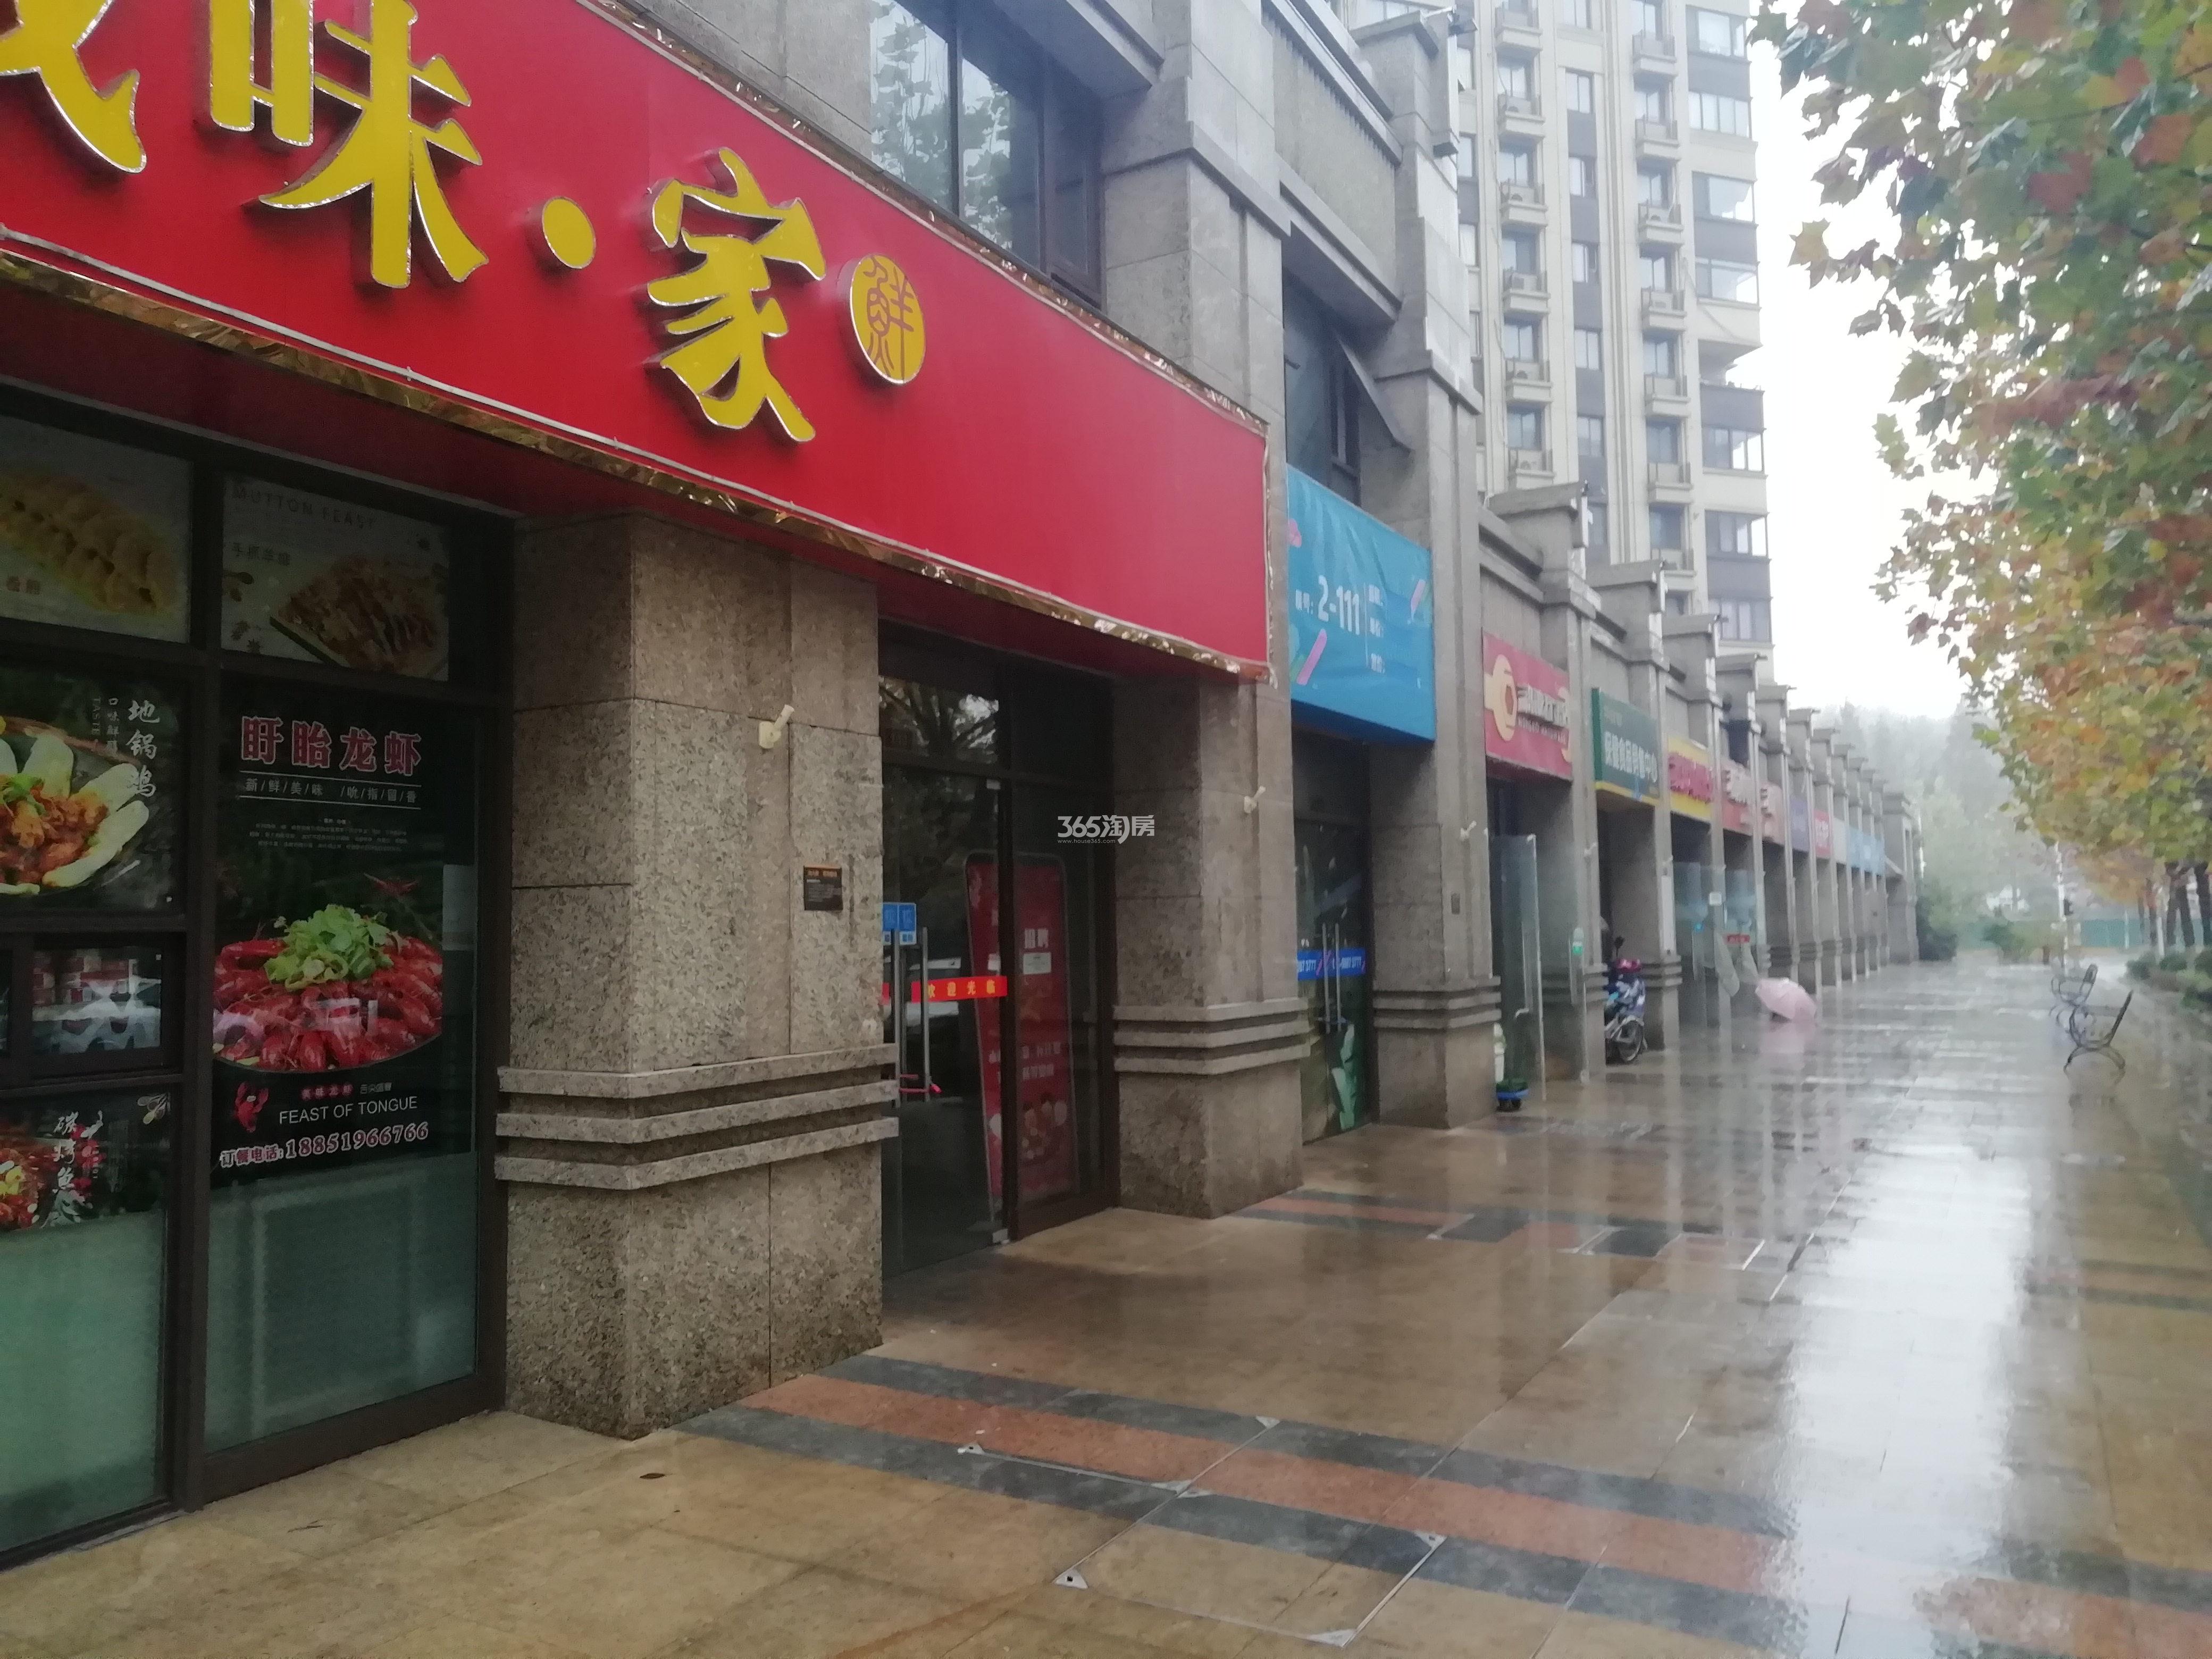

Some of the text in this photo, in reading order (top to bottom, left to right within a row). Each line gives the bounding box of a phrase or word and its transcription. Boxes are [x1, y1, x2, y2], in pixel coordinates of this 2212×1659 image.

[241, 715, 422, 776] 盱眙龙虾
[279, 1096, 418, 1125] FEAST OF TONGUE
